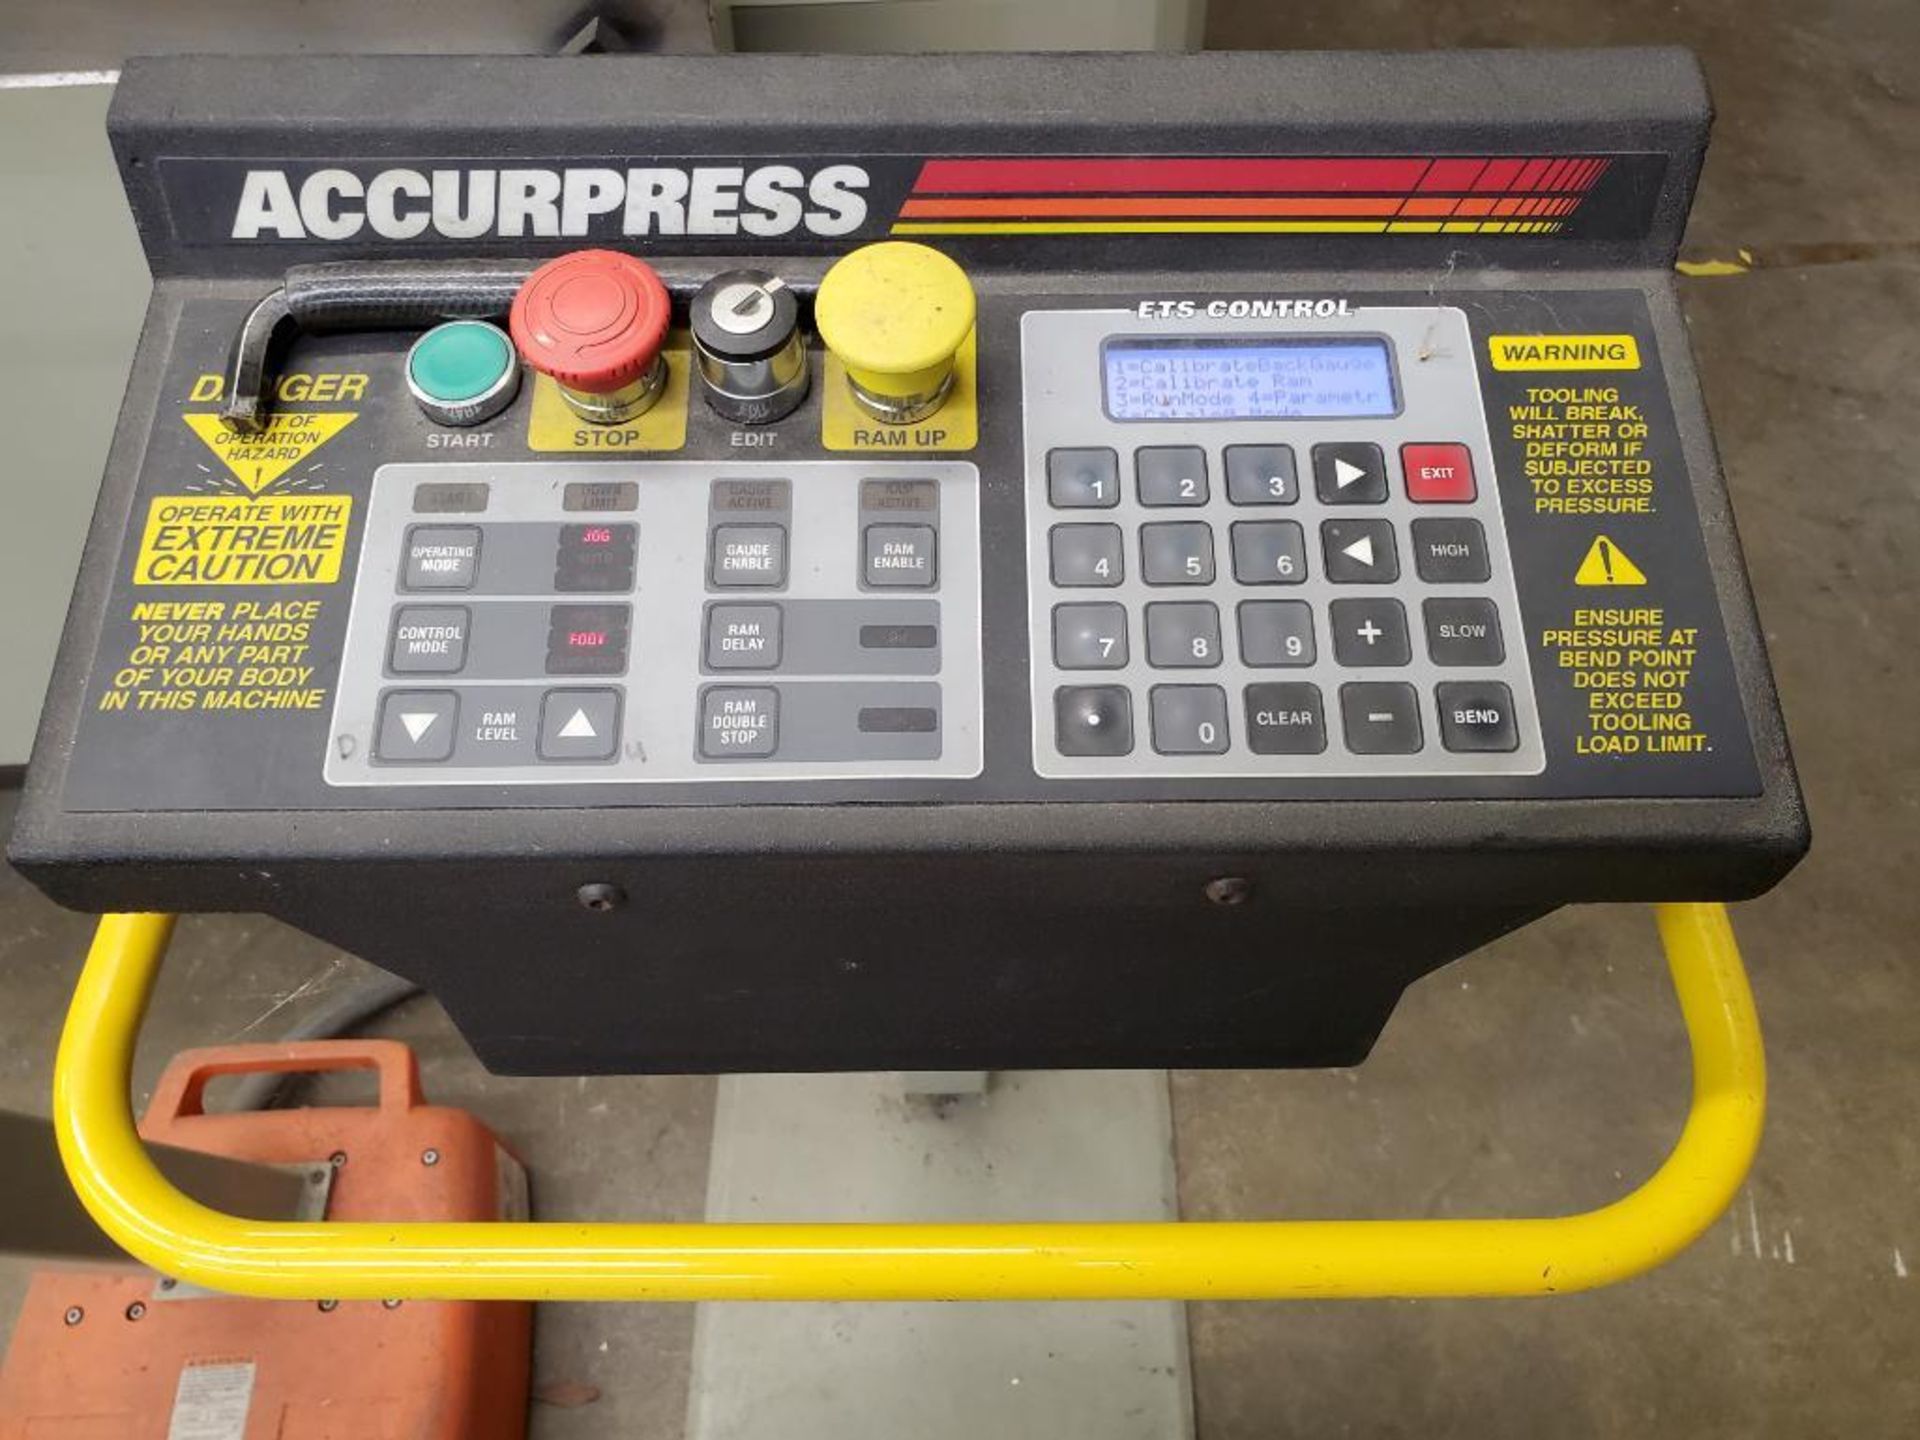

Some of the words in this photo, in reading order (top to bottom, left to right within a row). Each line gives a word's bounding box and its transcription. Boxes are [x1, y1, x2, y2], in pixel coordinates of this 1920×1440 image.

[232, 164, 869, 239] ACCURPRESS
[1138, 300, 1194, 319] ETS
[1207, 299, 1354, 317] CONTROL
[1502, 344, 1626, 360] WARNING
[190, 374, 370, 401] DGER
[1527, 389, 1618, 403] TOOLING
[1509, 406, 1559, 421] WILL
[289, 416, 318, 428] OF
[215, 431, 321, 445] OPERATION
[574, 430, 639, 447] STOP
[731, 432, 778, 447] EDIT
[855, 430, 909, 447] RAM
[915, 430, 946, 447] UP
[1512, 424, 1610, 439] SHATTER
[1617, 424, 1648, 438] OR
[426, 432, 493, 449] START
[226, 447, 302, 461] HAZARD
[1527, 442, 1617, 458] DEFORM
[1623, 442, 1643, 456] IF
[1421, 466, 1455, 480] EXIT
[1524, 461, 1651, 476] SUBJECTED
[1091, 481, 1104, 498] 1
[1181, 479, 1195, 497] 2
[1269, 478, 1285, 496] 3
[1530, 479, 1559, 494] TO
[1566, 479, 1653, 494] EXCESS
[158, 505, 273, 522] OPERATE
[280, 504, 342, 521] WITH
[1535, 497, 1656, 514] PRESSURE.
[152, 525, 341, 551] EXTREME
[583, 529, 610, 543] JOG
[411, 546, 473, 558] OPERATING
[726, 544, 770, 556] GAUGE
[883, 543, 914, 555] RAM
[1431, 544, 1469, 558] HIGH
[148, 554, 323, 581] CAUTION
[421, 558, 461, 572] MODE
[723, 557, 773, 570] ENABLE
[873, 557, 925, 570] ENABLE
[1094, 559, 1110, 577] 4
[1186, 558, 1201, 576] 5
[1276, 557, 1292, 575] 6
[131, 603, 225, 620] NEVER
[231, 602, 321, 619] PLACE
[1575, 610, 1664, 626] ENSURE
[140, 624, 210, 642] YOUR
[218, 623, 310, 641] HANDS
[399, 626, 462, 640] CONTROL
[728, 624, 760, 636] RAM
[1440, 624, 1486, 639] SLOW
[1543, 630, 1662, 646] PRESSURE
[1669, 629, 1698, 645] AT
[408, 640, 449, 654] MODE
[722, 638, 765, 651] DELAY
[1099, 639, 1114, 657] 7
[1193, 639, 1208, 657] 8
[1285, 637, 1301, 656] 9
[130, 646, 167, 665] OR
[175, 646, 234, 664] ANY
[238, 645, 307, 664] PART
[1559, 651, 1621, 667] BEND
[1629, 650, 1696, 667] POINT
[115, 669, 153, 687] OF
[162, 668, 232, 686] YOUR
[239, 667, 314, 686] BODY
[1574, 672, 1636, 688] DOES
[1643, 671, 1690, 687] NOT
[100, 691, 130, 710] IN
[139, 690, 197, 709] THIS
[202, 689, 325, 709] MACHINE
[724, 701, 756, 713] RAM
[1590, 693, 1682, 709] EXCEED
[482, 712, 517, 725] RAM
[712, 714, 767, 729] DOUBLE
[1257, 712, 1312, 726] CLEAR
[1454, 709, 1500, 725] BEND
[1588, 714, 1691, 731] TOOLING
[476, 727, 519, 741] LEVEL
[720, 730, 758, 744] STOP
[1199, 723, 1214, 742] 0
[1577, 736, 1640, 753] LOAD
[1647, 735, 1713, 753] LIMIT.
